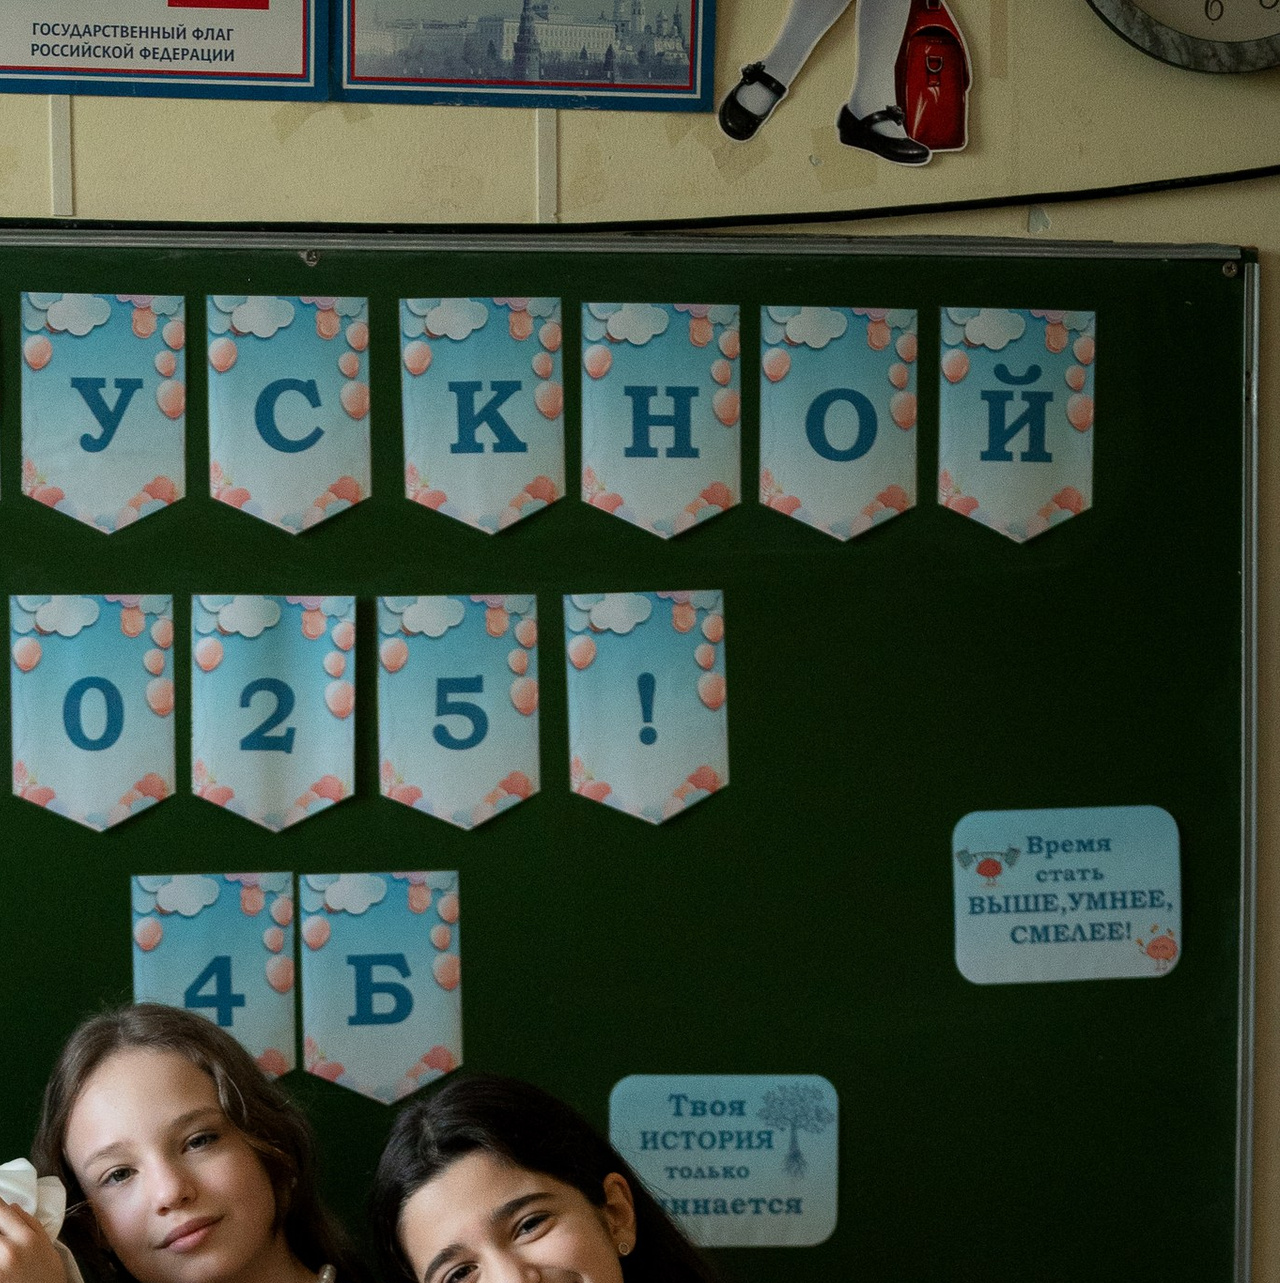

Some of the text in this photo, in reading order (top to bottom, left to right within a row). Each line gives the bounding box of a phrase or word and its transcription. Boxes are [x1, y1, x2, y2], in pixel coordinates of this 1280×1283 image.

[32, 22, 234, 41] ГОСУДАРСТВЕННЫЙ ФЛАГ
[30, 42, 235, 62] РОССИЙСКОЙ ФЕДЕРАЦИИ
[1026, 835, 1113, 859] Время
[1035, 867, 1104, 883] стать
[1010, 922, 1132, 944] СМЕЛЕЕ!
[668, 1093, 747, 1117] Твоя
[640, 1129, 774, 1151] ИСТОРИЯ
[664, 1165, 750, 1180] только
